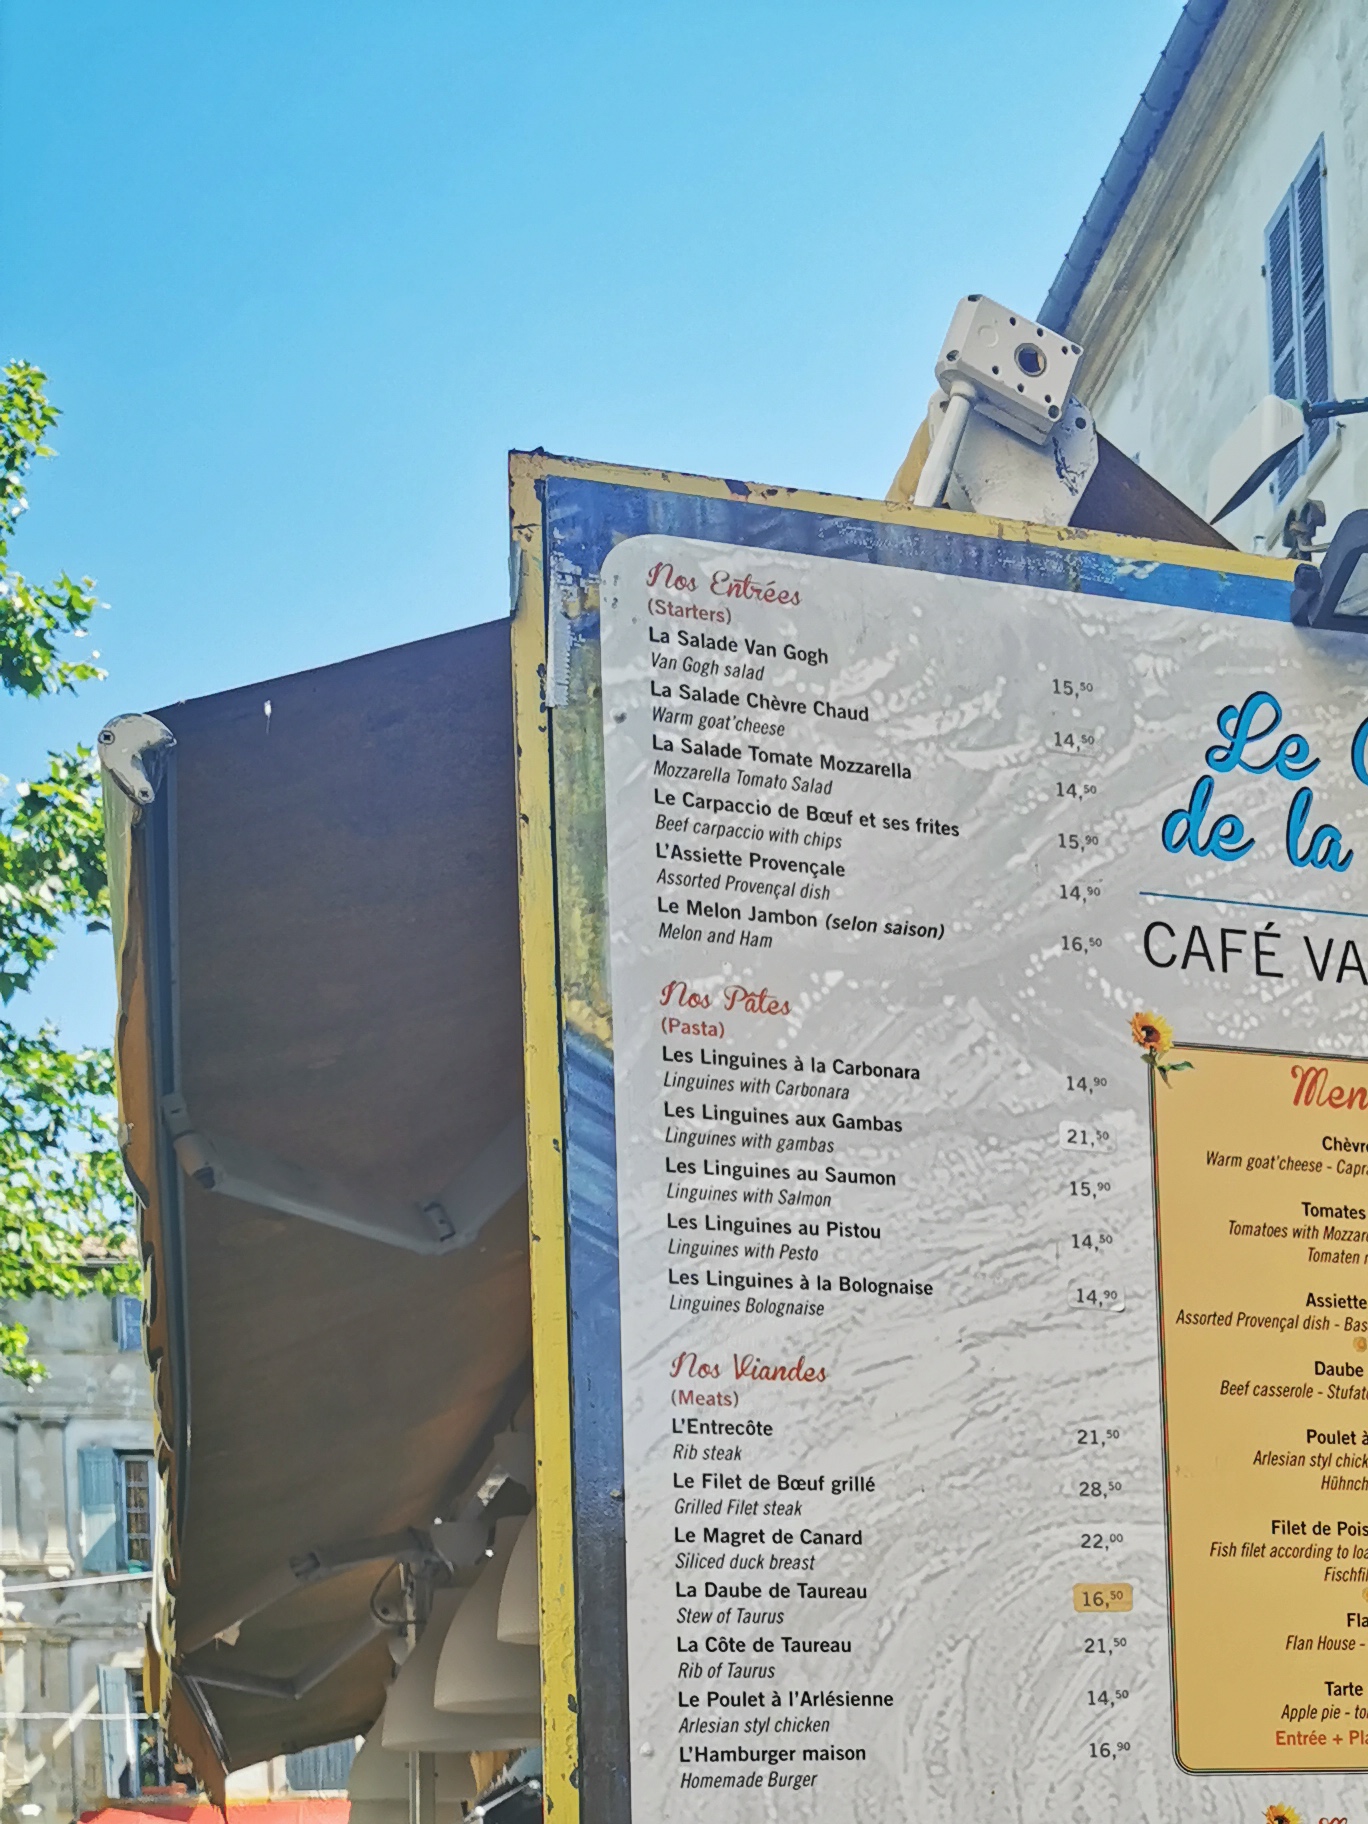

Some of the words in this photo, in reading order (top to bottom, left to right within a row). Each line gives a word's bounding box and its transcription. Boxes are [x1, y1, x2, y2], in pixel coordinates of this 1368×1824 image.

[645, 560, 697, 592] Nos
[708, 570, 801, 606] Entrées
[647, 597, 732, 625] (Starters)
[647, 625, 670, 644] La
[676, 628, 738, 653] Salade
[743, 637, 777, 658] Van
[782, 642, 829, 667] Gogh
[1204, 690, 1321, 781] Le
[1161, 775, 1256, 862] de
[1285, 786, 1354, 873] la
[656, 895, 680, 914] Le
[685, 898, 742, 920] Melon
[747, 904, 818, 928] Jambon
[824, 912, 878, 933] (selon
[882, 919, 945, 941] saison)
[1142, 920, 1284, 979] CAFÉ
[658, 979, 711, 1009] Nos
[723, 984, 791, 1016] Pâtes
[660, 1015, 725, 1039] (Pasta)
[663, 1099, 695, 1119] Les
[701, 1102, 789, 1126] Linguines
[794, 1113, 826, 1128] aux
[831, 1111, 903, 1133] Gambas
[1304, 1291, 1368, 1310] Assiette
[668, 1350, 721, 1379] Nos
[732, 1352, 827, 1383] Viandes
[670, 1388, 739, 1408] (Meats)
[671, 1416, 774, 1437] L'Entrecôte
[672, 1442, 698, 1460] Rib
[701, 1444, 742, 1461] steak
[1323, 1680, 1364, 1697] Tarte
[679, 1770, 764, 1789] Homemade
[766, 1769, 818, 1791] Burger
